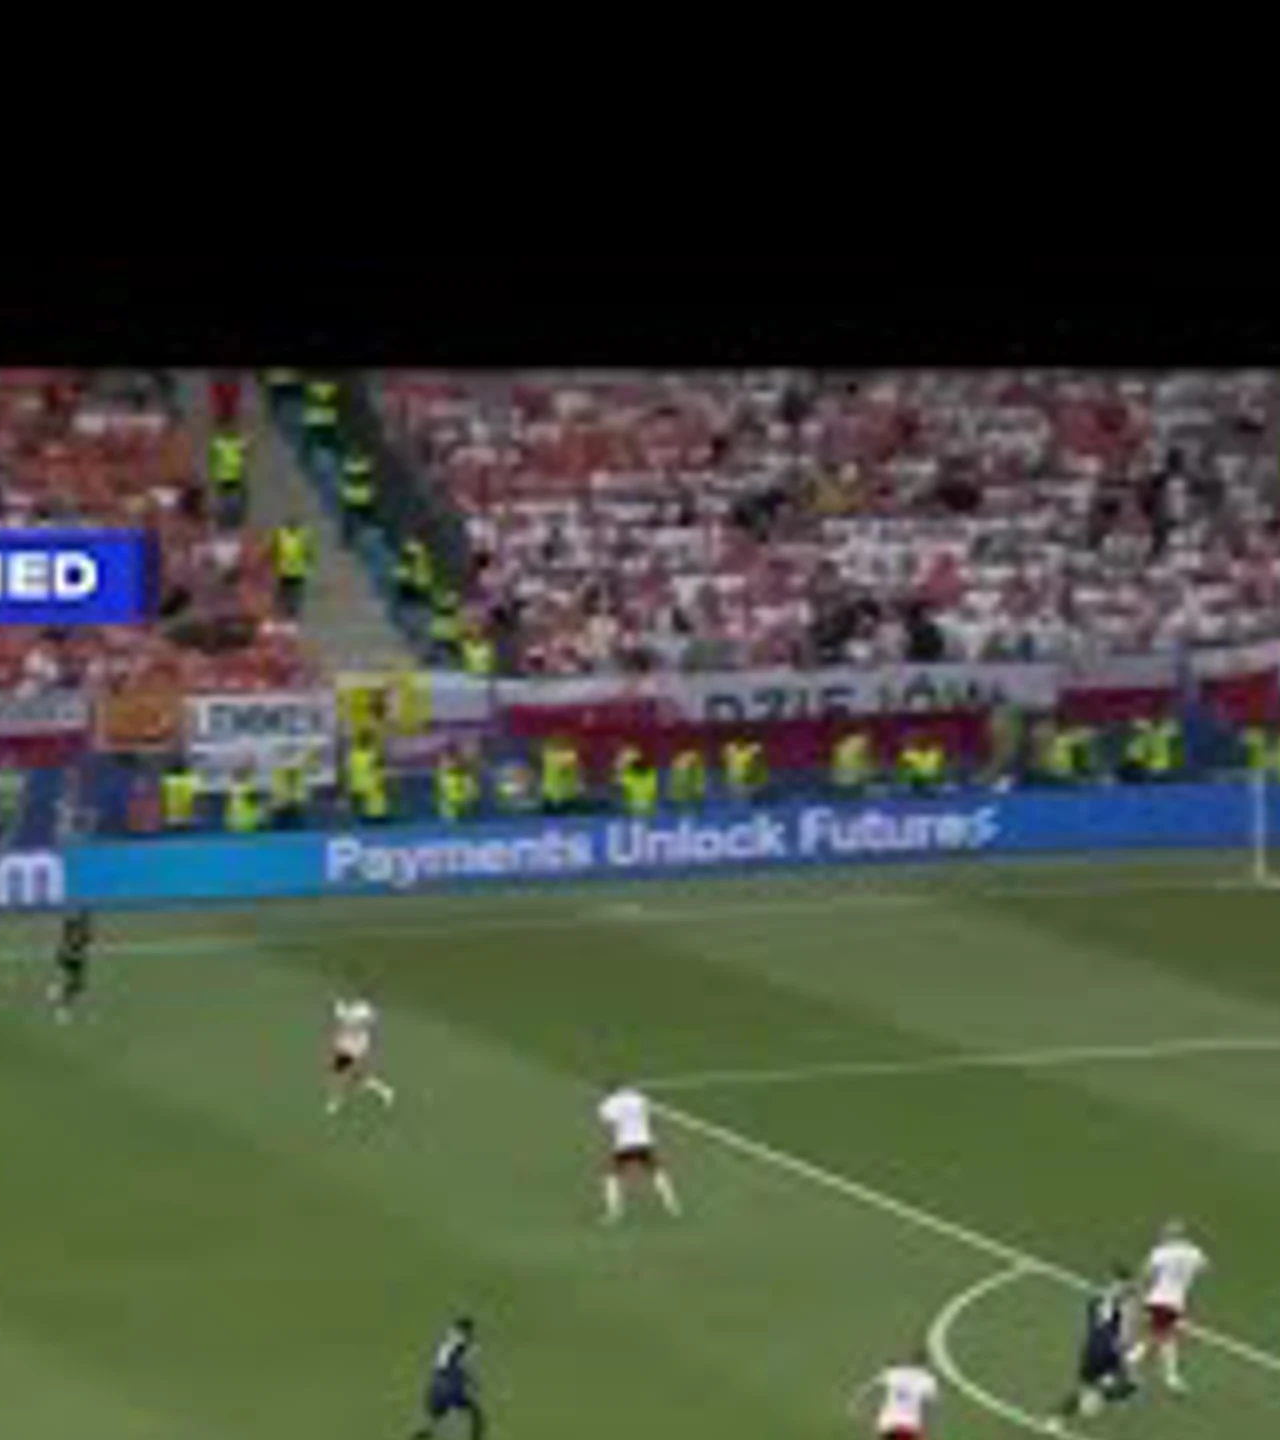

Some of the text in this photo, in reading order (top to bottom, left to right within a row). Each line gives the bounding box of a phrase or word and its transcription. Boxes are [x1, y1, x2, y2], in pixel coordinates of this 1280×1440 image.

[324, 802, 1002, 889] Payments Unlock Futures
